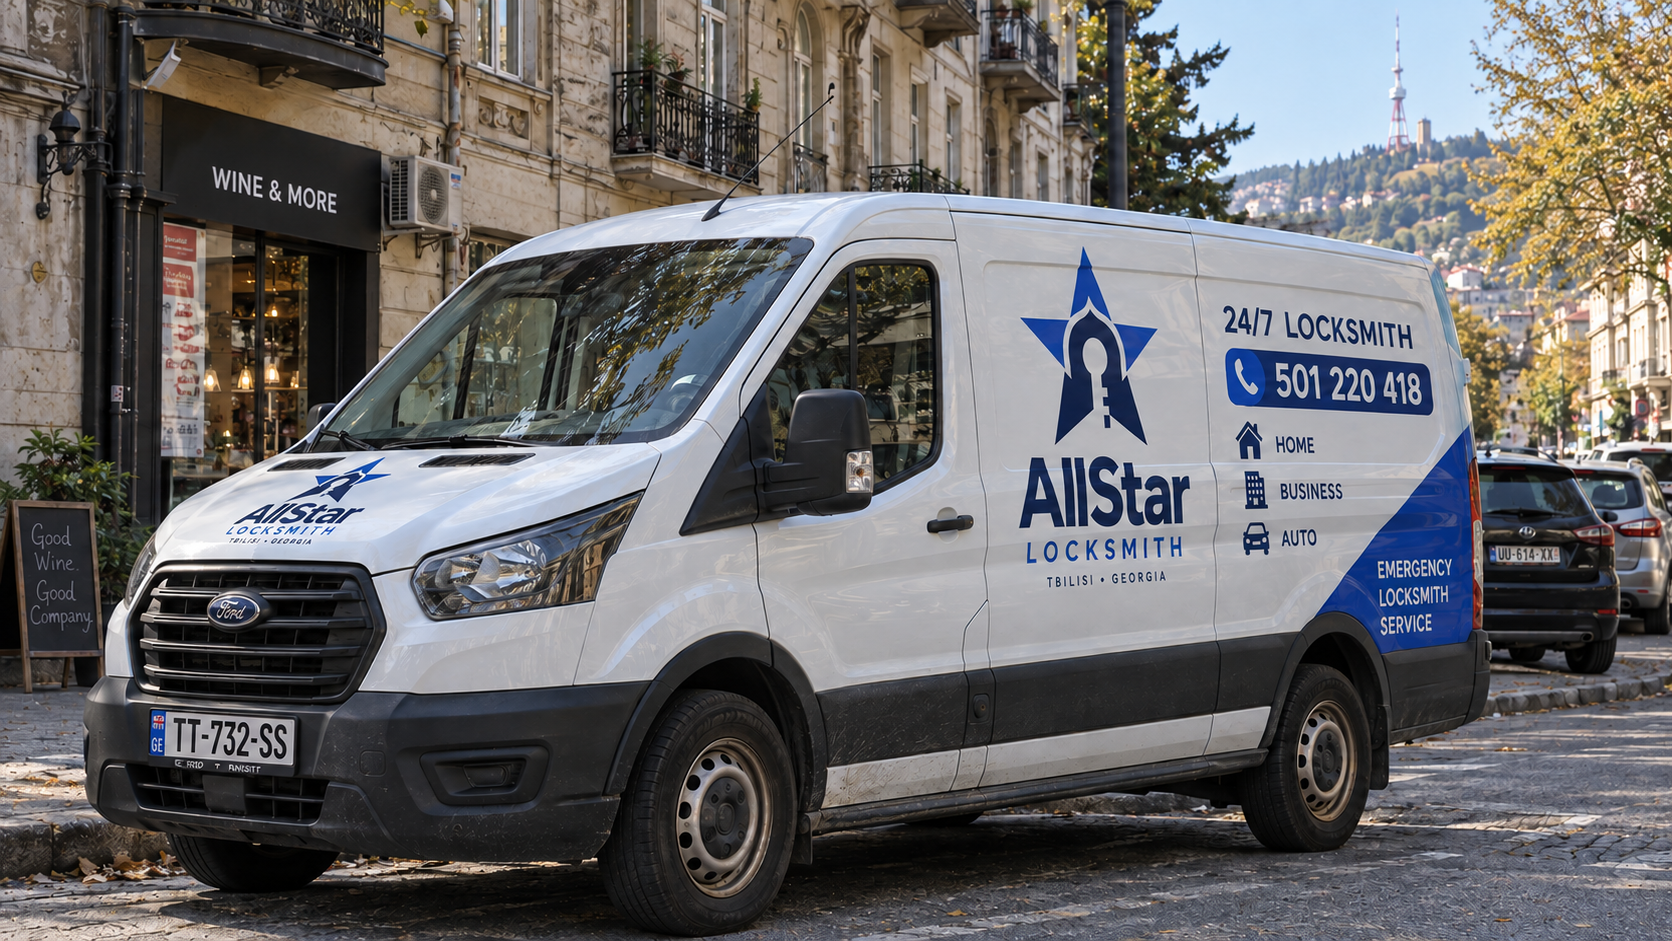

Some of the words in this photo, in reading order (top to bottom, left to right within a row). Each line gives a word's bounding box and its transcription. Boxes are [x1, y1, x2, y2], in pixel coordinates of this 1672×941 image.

[212, 166, 263, 198] WINE
[269, 180, 282, 202] &
[288, 183, 337, 214] MORE
[1223, 305, 1273, 337] 24/7
[1284, 311, 1413, 349] LOCKSMITH
[1275, 362, 1321, 400] 501
[1329, 366, 1376, 403] 220
[1383, 371, 1423, 406] 418
[1275, 436, 1315, 453] HOME
[1019, 456, 1190, 528] AllStar
[1280, 483, 1343, 500] BUSINESS
[233, 502, 365, 525] AllStar
[31, 522, 72, 550] Good
[226, 525, 337, 536] LOCKSMITH
[1281, 529, 1317, 546] AUTO
[34, 551, 79, 571] Wine.
[1026, 536, 1182, 564] LOCKSMITH
[1498, 547, 1553, 561] UU-614-XX
[1047, 574, 1093, 588] TBILISI
[1111, 571, 1166, 584] GEORGIA
[1377, 558, 1452, 579] EMERGENCY
[36, 579, 76, 607] Good
[1379, 585, 1449, 607] LOCKSMITH
[216, 599, 247, 620] Ford
[1380, 613, 1432, 636] SERVICE
[151, 737, 163, 752] GE
[173, 717, 288, 760] TT-732-SS
